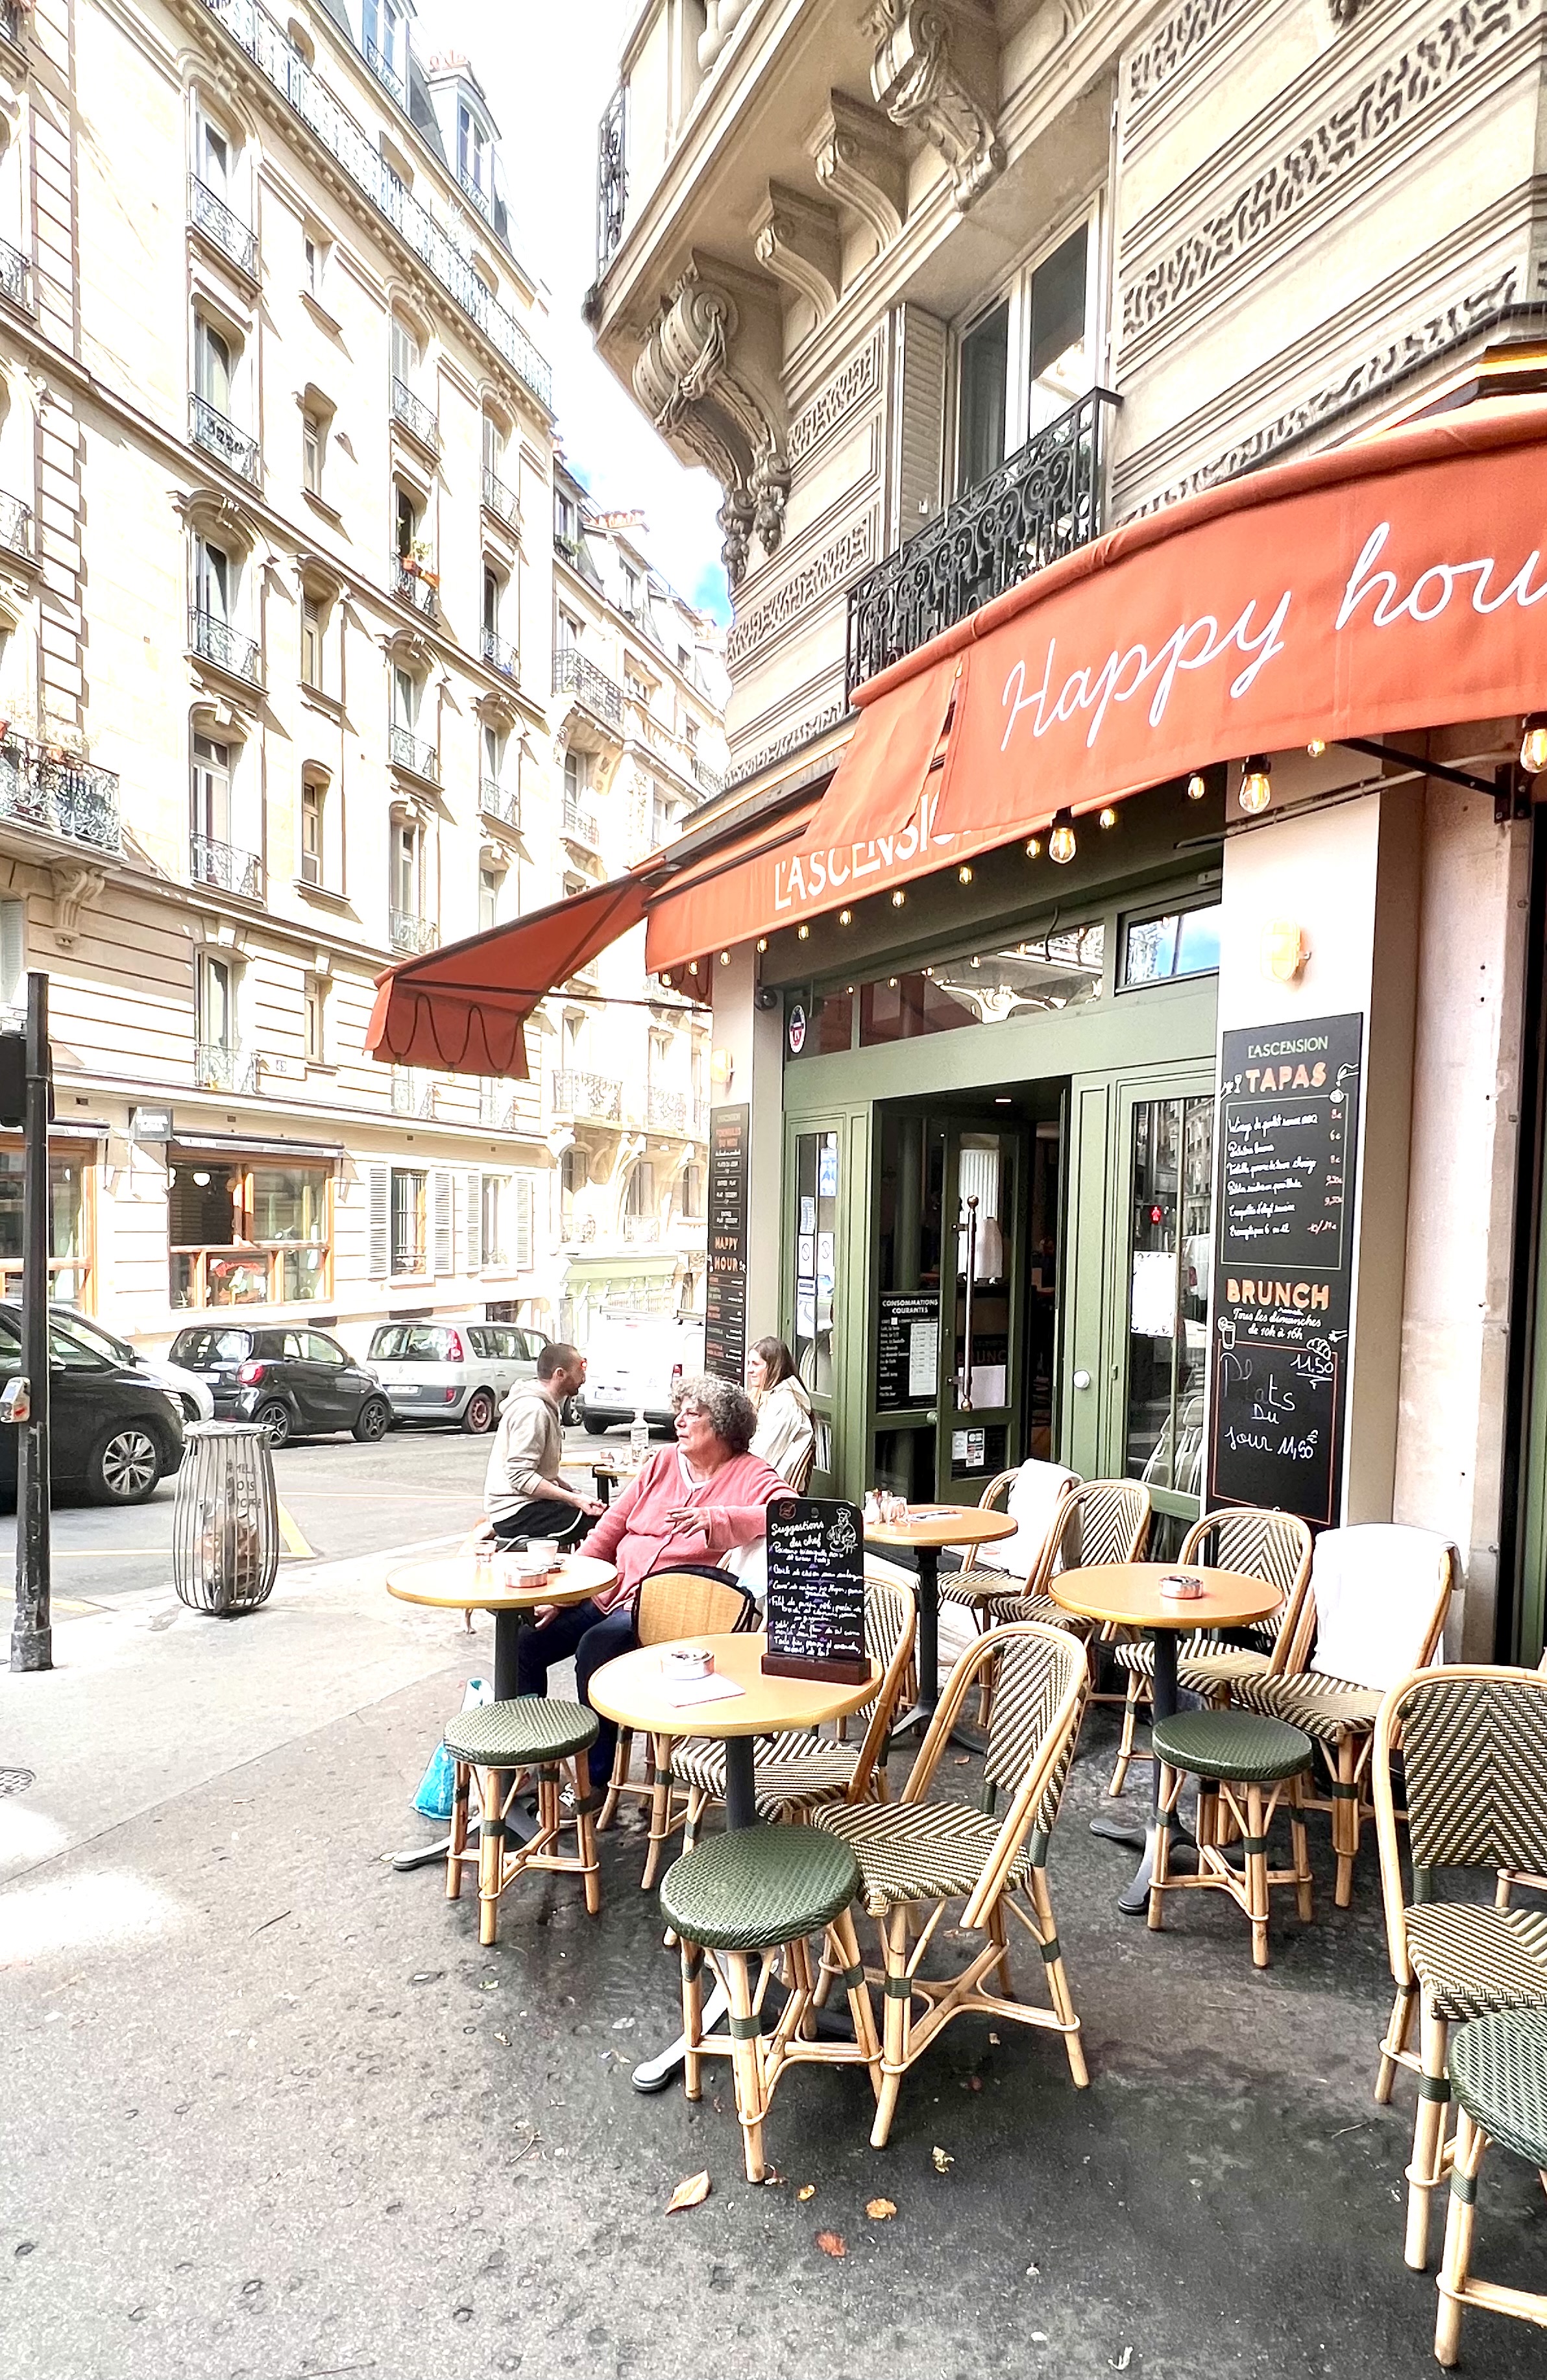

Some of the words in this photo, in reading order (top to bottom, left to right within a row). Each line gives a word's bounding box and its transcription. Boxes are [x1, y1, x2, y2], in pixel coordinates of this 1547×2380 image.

[1001, 591, 1291, 751] Happy
[774, 791, 971, 911] L'ASCENSI
[1247, 1035, 1329, 1059] L'ASCENSION
[1245, 1061, 1327, 1094] TAPAS
[714, 1236, 738, 1251] HAPPY
[714, 1256, 738, 1272] HOUR
[1226, 1279, 1329, 1310] BRUNCH
[892, 1306, 929, 1314] COURANTES
[1233, 1307, 1254, 1321] Tous
[1254, 1308, 1268, 1322] les
[1269, 1310, 1321, 1328] dimanches
[1248, 1323, 1259, 1336] de
[1260, 1325, 1276, 1337] 10h
[1287, 1327, 1303, 1340] 16h
[772, 1520, 824, 1536] Suggestions
[790, 1536, 802, 1548] du
[803, 1532, 822, 1549] chef
